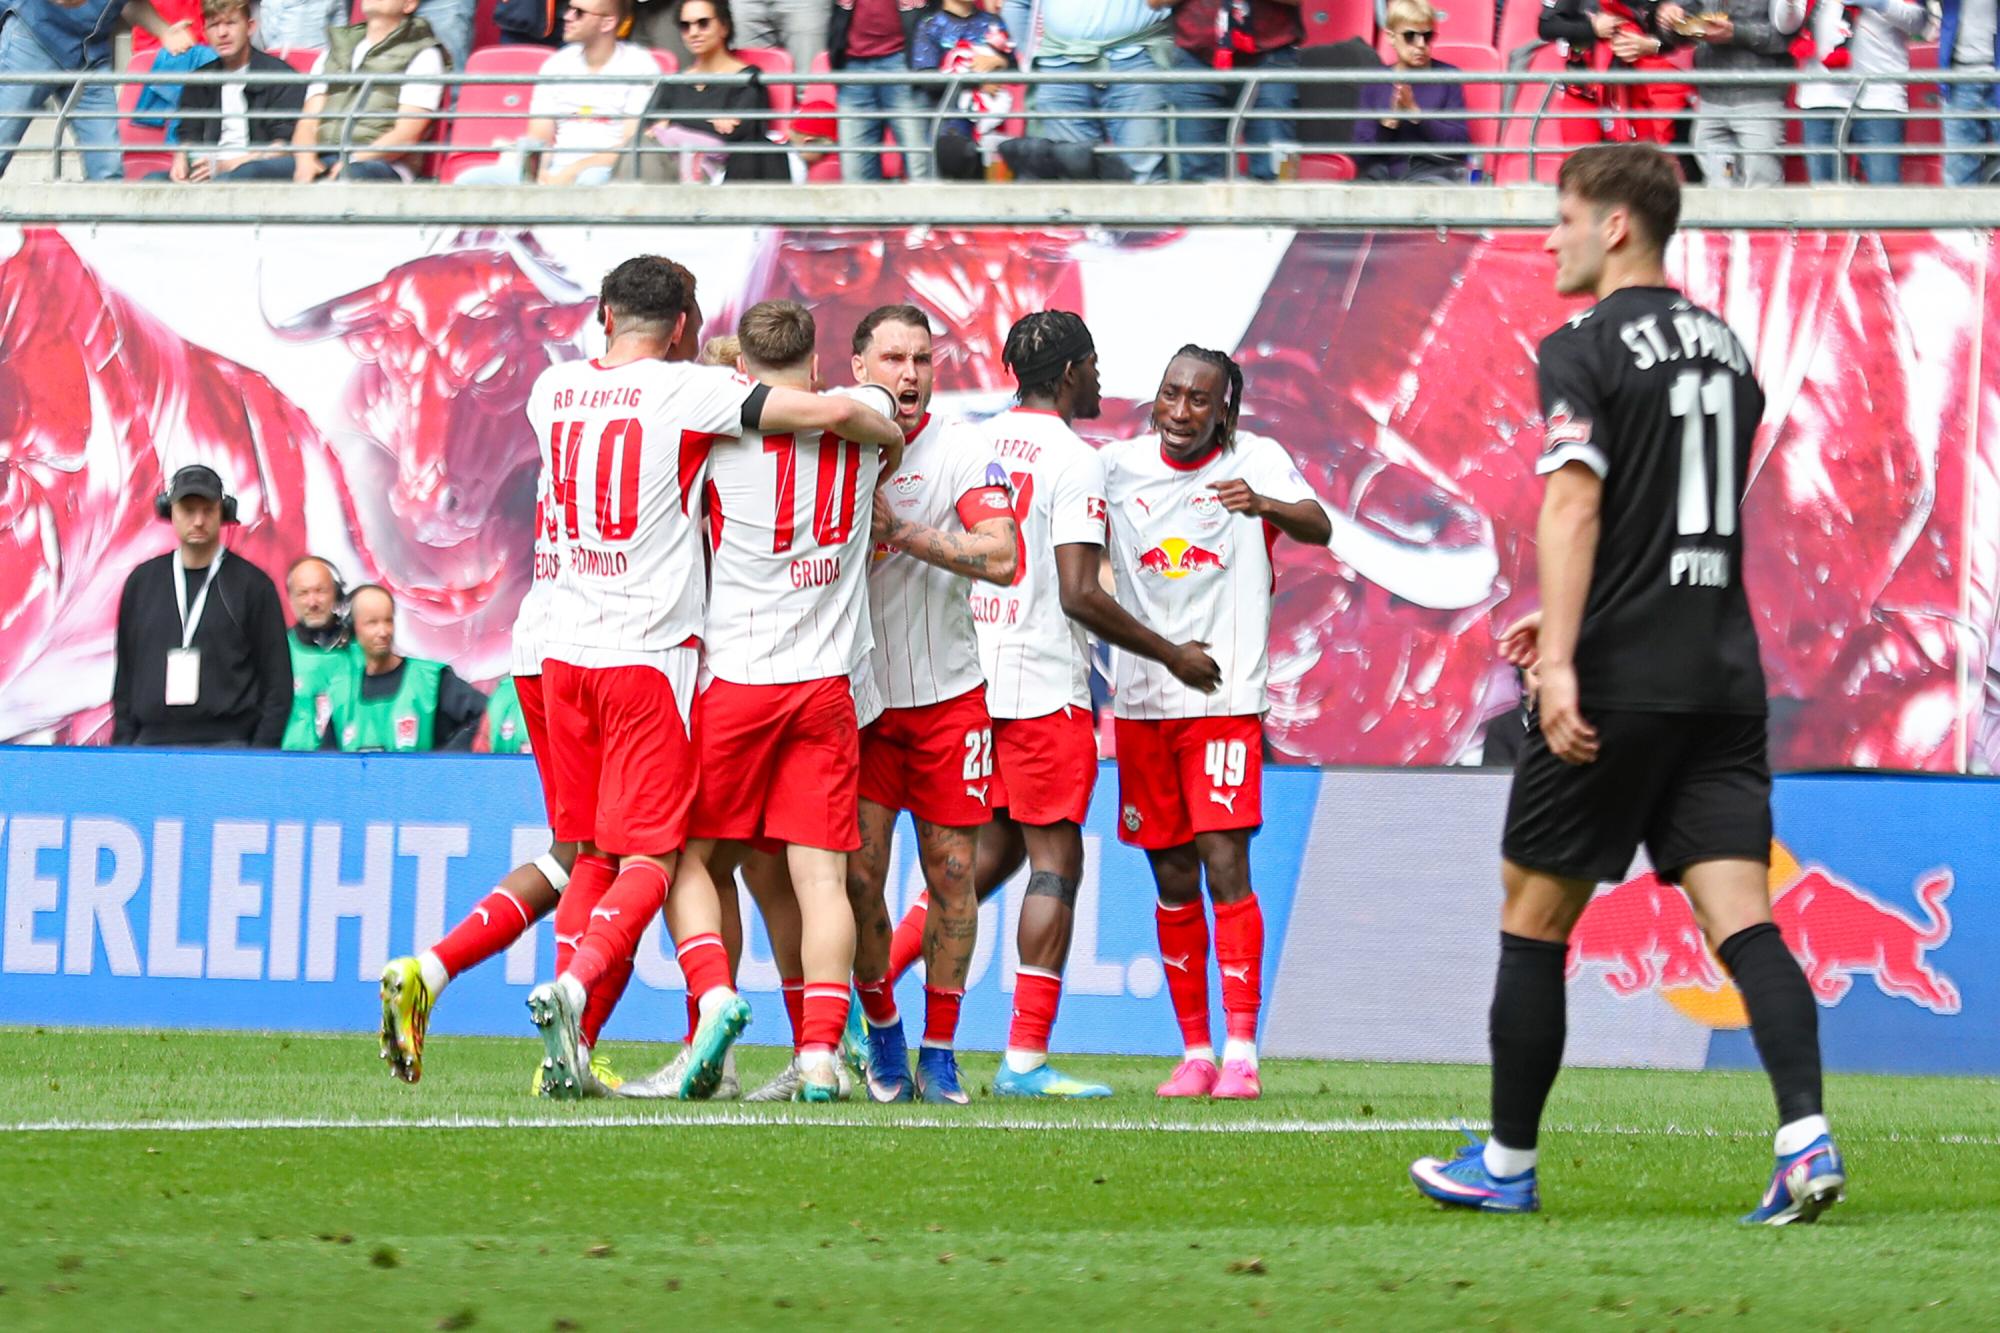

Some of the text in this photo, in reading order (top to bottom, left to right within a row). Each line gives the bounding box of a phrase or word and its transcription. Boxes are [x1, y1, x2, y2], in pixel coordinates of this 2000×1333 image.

[553, 387, 642, 410] RB LEIPZIG
[551, 417, 644, 543] 40
[762, 429, 861, 555] 10
[1669, 366, 1736, 537] 11
[790, 556, 840, 589] GRUDA
[963, 727, 993, 780] 22
[1204, 739, 1247, 788] 49
[0, 815, 470, 984] ERLEIHT
